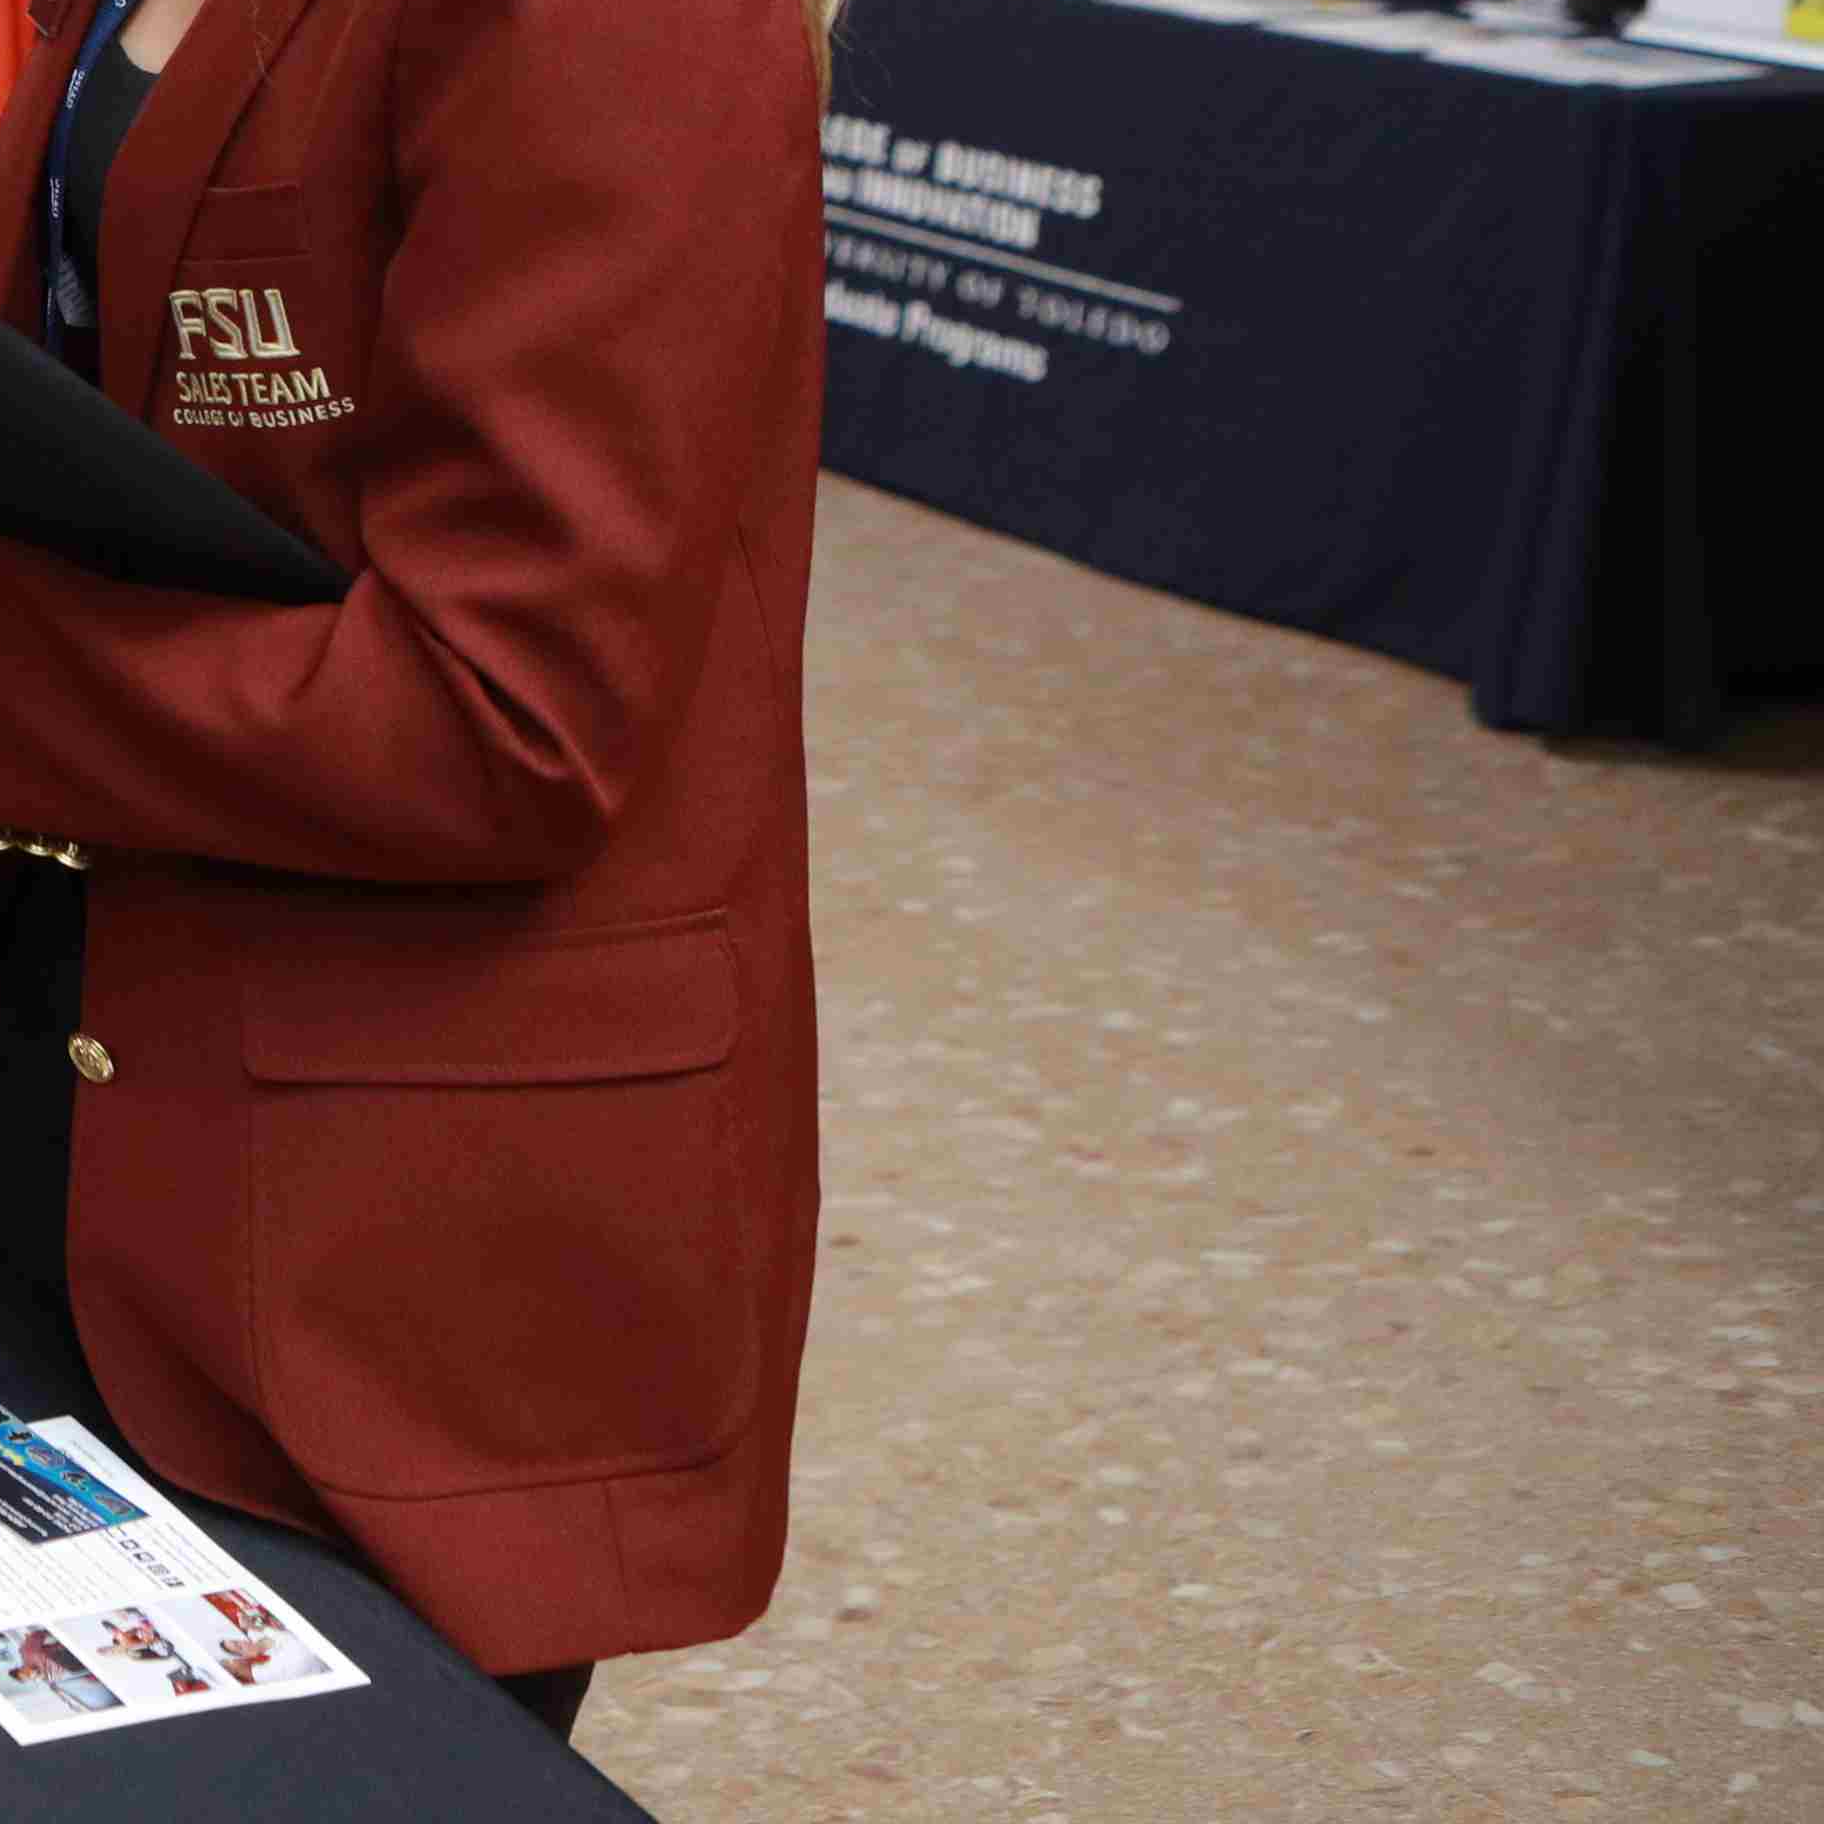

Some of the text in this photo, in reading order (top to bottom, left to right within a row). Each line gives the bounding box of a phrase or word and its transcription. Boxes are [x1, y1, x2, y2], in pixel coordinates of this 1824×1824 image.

[168, 287, 302, 360] FSU
[900, 298, 1050, 383] Programs
[1016, 283, 1171, 356] TOLEDO
[173, 407, 226, 426] COLLEGE
[248, 396, 356, 429] BUSINESS
[175, 367, 332, 407] SALES TEAM
